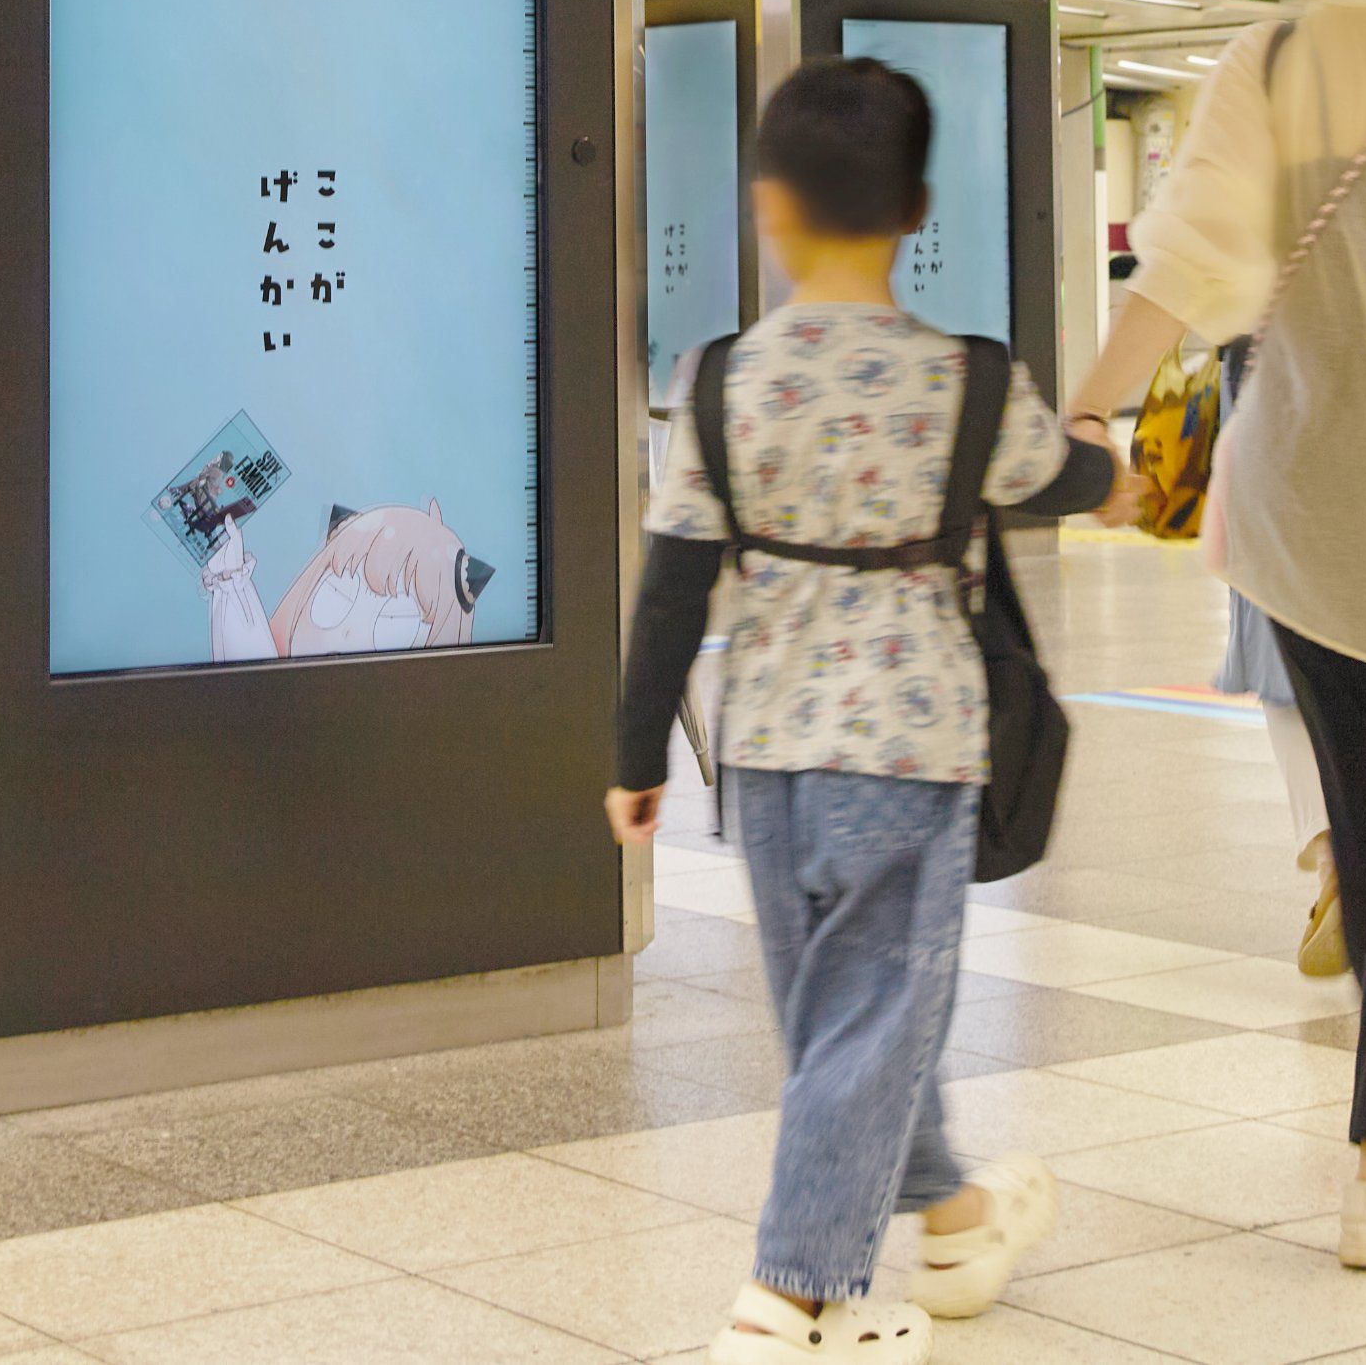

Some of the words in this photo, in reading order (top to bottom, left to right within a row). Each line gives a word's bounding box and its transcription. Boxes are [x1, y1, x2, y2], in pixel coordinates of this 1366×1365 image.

[260, 170, 298, 352] げんかい
[311, 170, 346, 304] ここが
[930, 222, 943, 274] ここが
